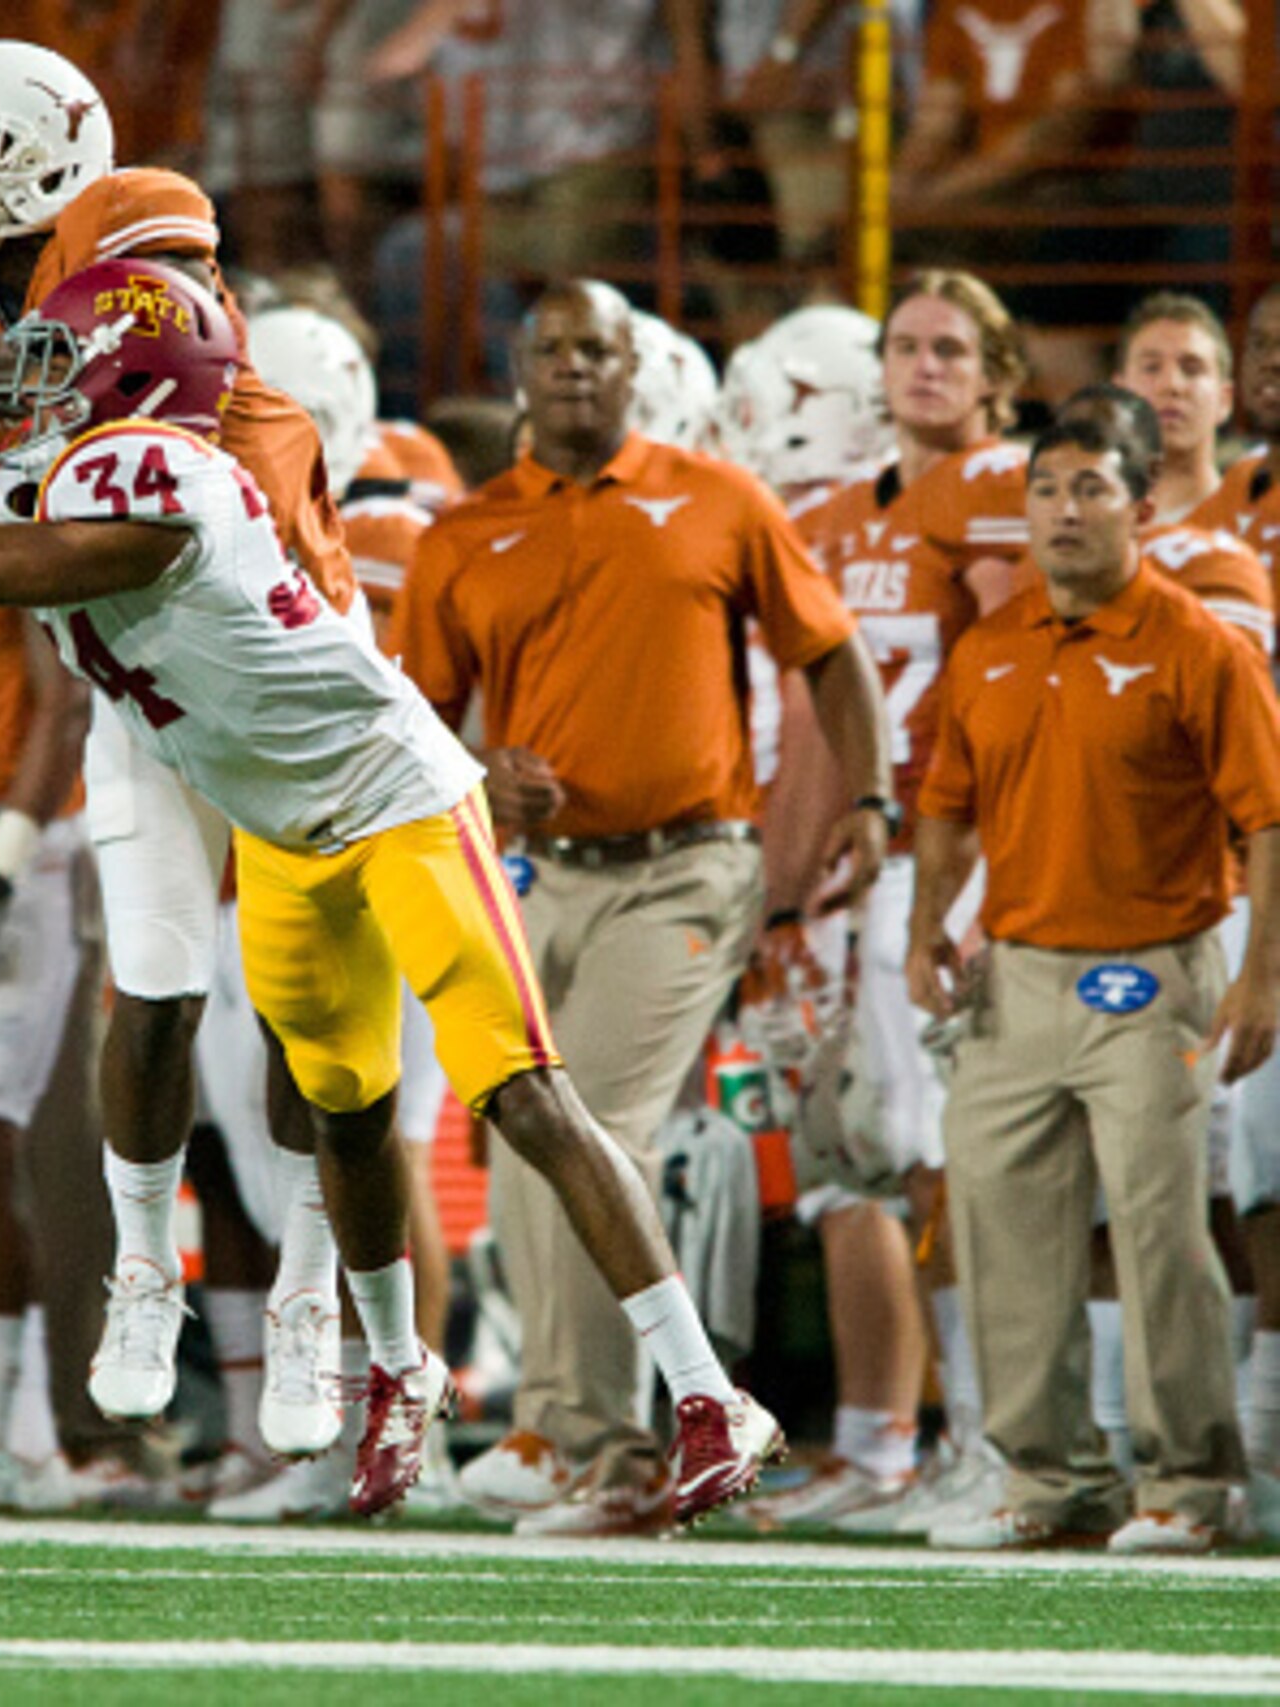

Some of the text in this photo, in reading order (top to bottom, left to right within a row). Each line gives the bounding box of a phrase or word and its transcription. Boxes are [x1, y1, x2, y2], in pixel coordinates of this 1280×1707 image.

[94, 287, 190, 334] STATE
[73, 445, 186, 521] 34
[43, 609, 187, 730] 4
